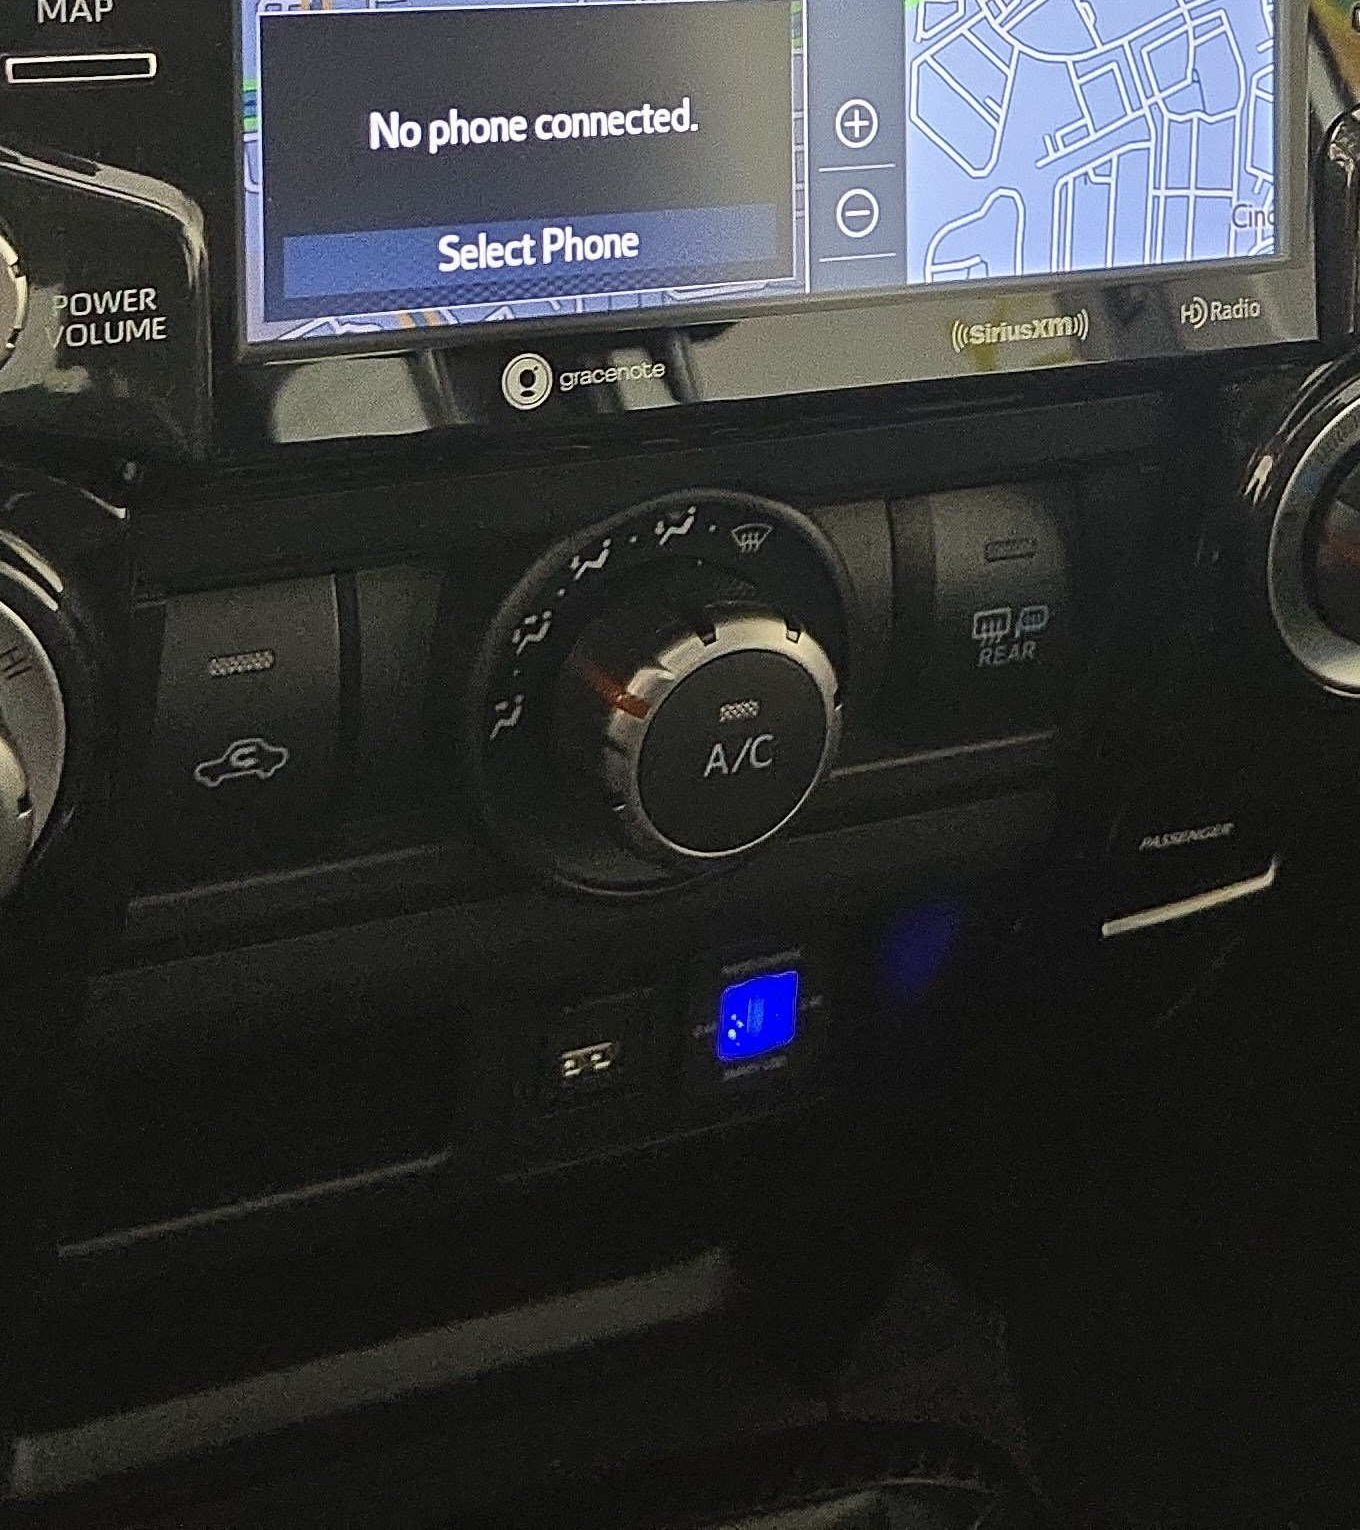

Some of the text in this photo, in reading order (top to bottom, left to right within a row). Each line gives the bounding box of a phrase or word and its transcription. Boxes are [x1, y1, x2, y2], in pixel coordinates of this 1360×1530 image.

[369, 97, 699, 153] No phone connected.
[439, 227, 638, 271] Select Phone
[53, 287, 157, 317] POWER
[1210, 298, 1261, 321] Radio
[46, 316, 167, 348] VOLUME
[559, 362, 666, 391] gracenote
[979, 642, 1037, 667] REAR
[704, 734, 774, 778] A/C
